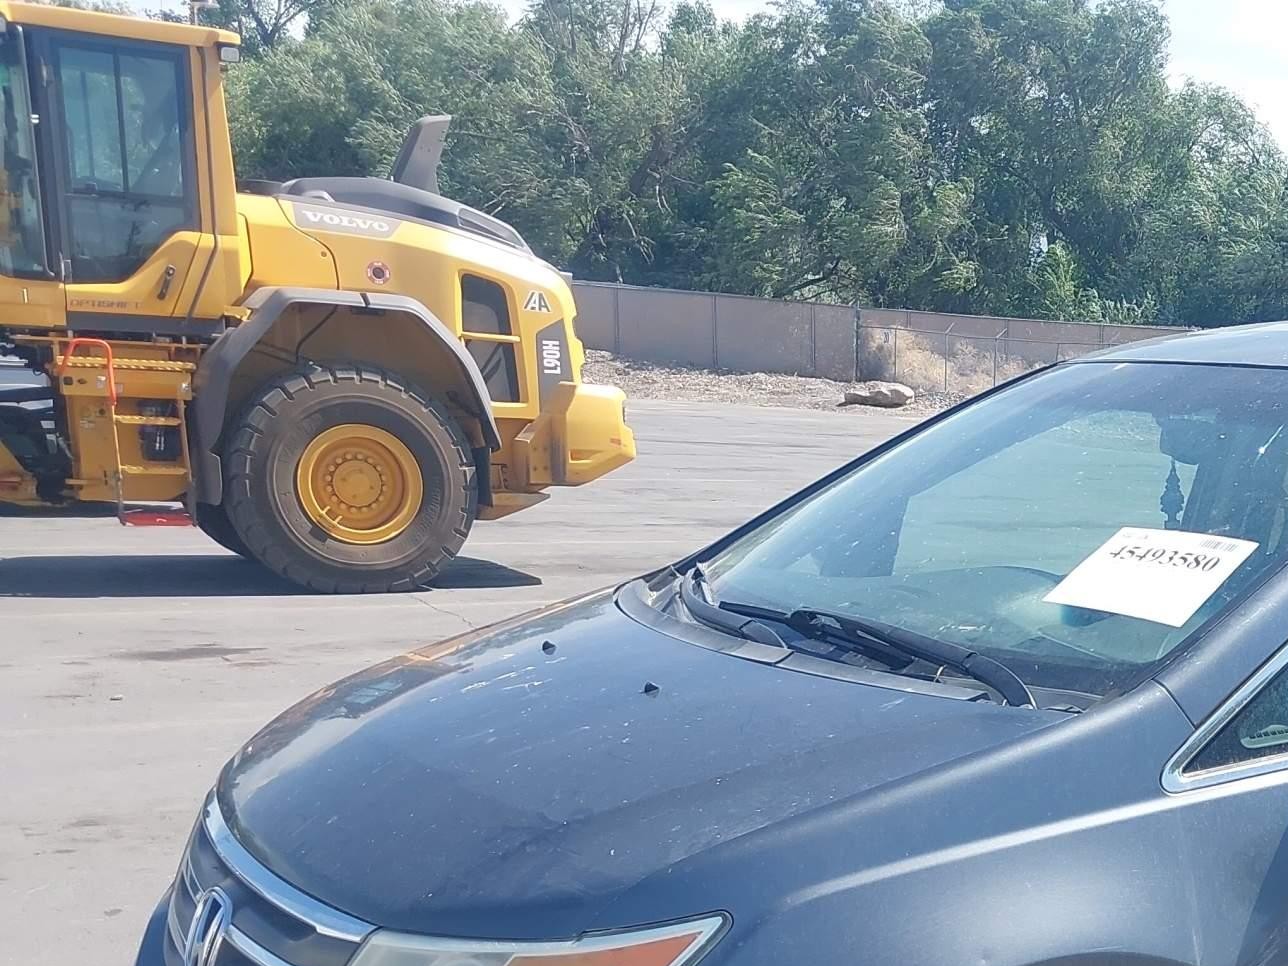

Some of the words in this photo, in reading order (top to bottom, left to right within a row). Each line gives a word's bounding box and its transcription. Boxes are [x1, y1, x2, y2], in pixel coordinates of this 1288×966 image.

[302, 210, 390, 232] VOLVO
[542, 340, 561, 374] L90H
[1109, 545, 1221, 572] 45493580
